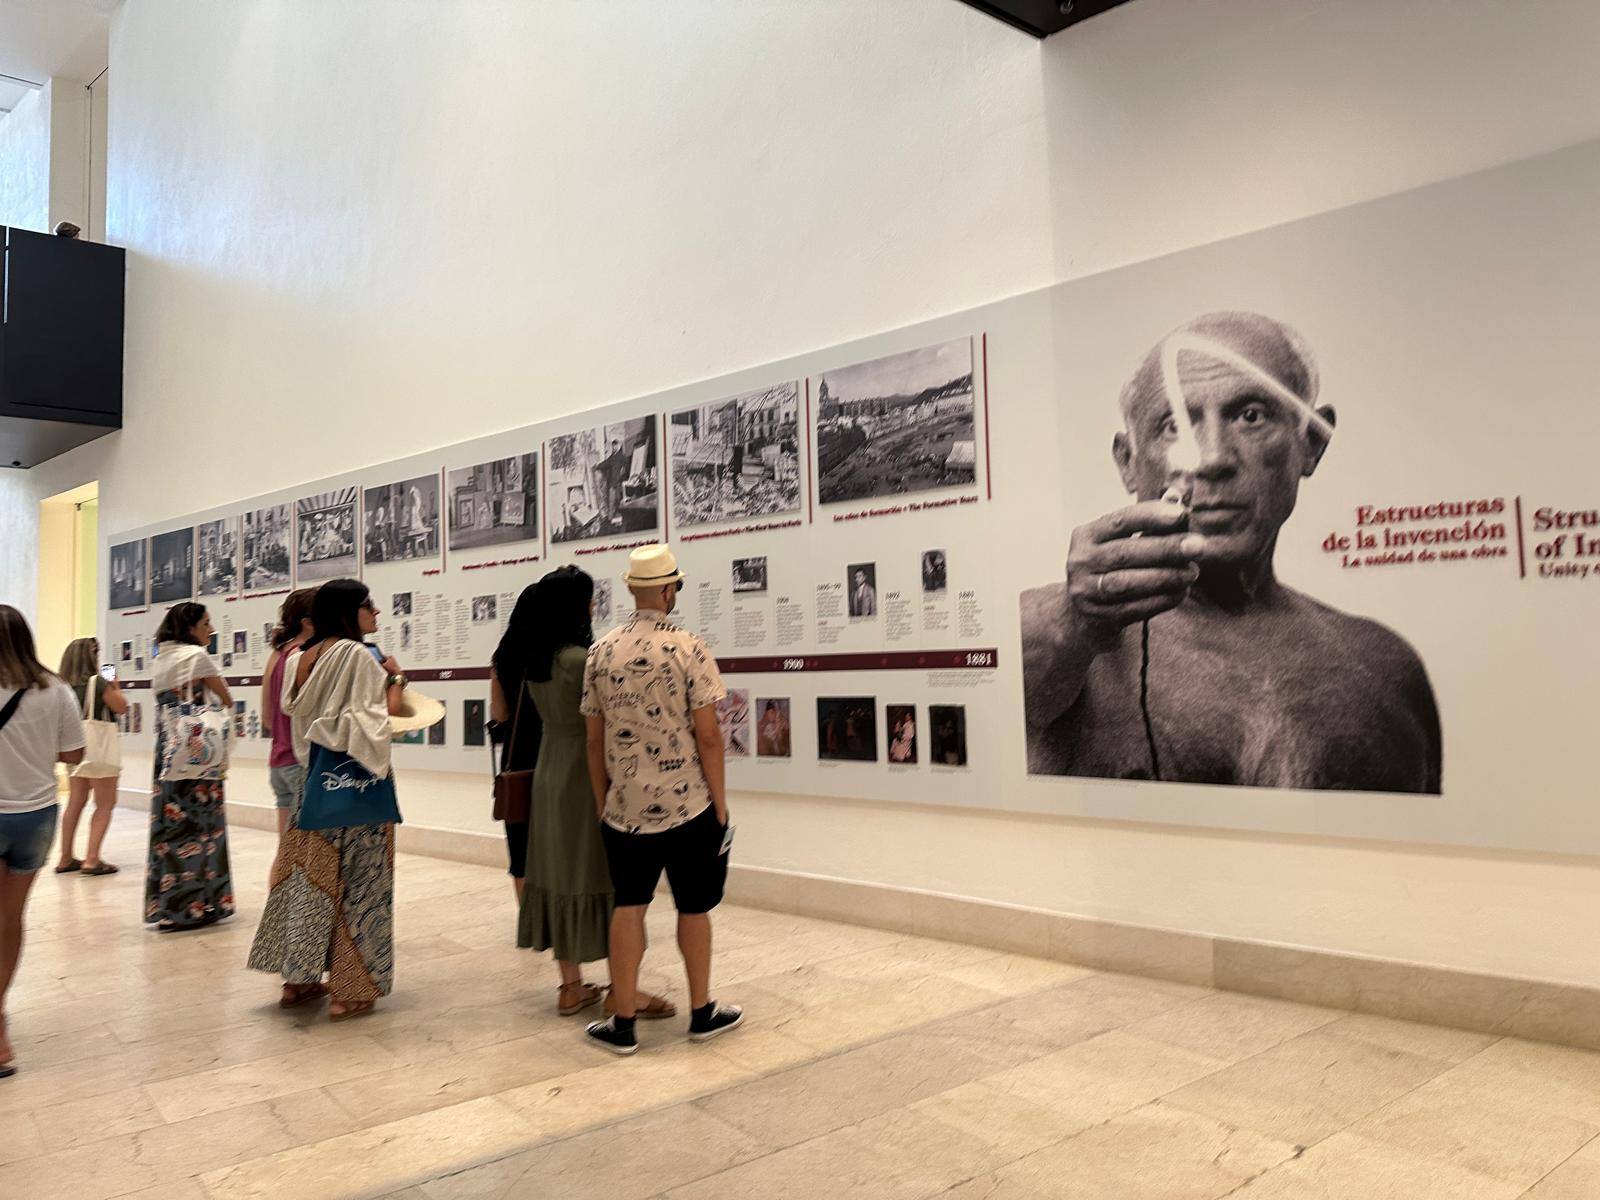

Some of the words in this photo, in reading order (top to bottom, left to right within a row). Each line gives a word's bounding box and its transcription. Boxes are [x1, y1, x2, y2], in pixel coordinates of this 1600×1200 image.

[1355, 497, 1505, 526] Estructuras
[1534, 506, 1600, 532] Stru
[1321, 531, 1352, 553] de
[1356, 528, 1378, 550] la
[1383, 518, 1505, 548] invención
[1534, 533, 1568, 561] of
[1341, 553, 1362, 568] La
[1364, 549, 1414, 567] unidad
[1417, 548, 1437, 562] de
[1439, 549, 1468, 562] una
[1470, 544, 1507, 559] obra
[1538, 561, 1591, 581] Unity
[782, 657, 804, 671] 1900
[965, 651, 992, 667] 1881
